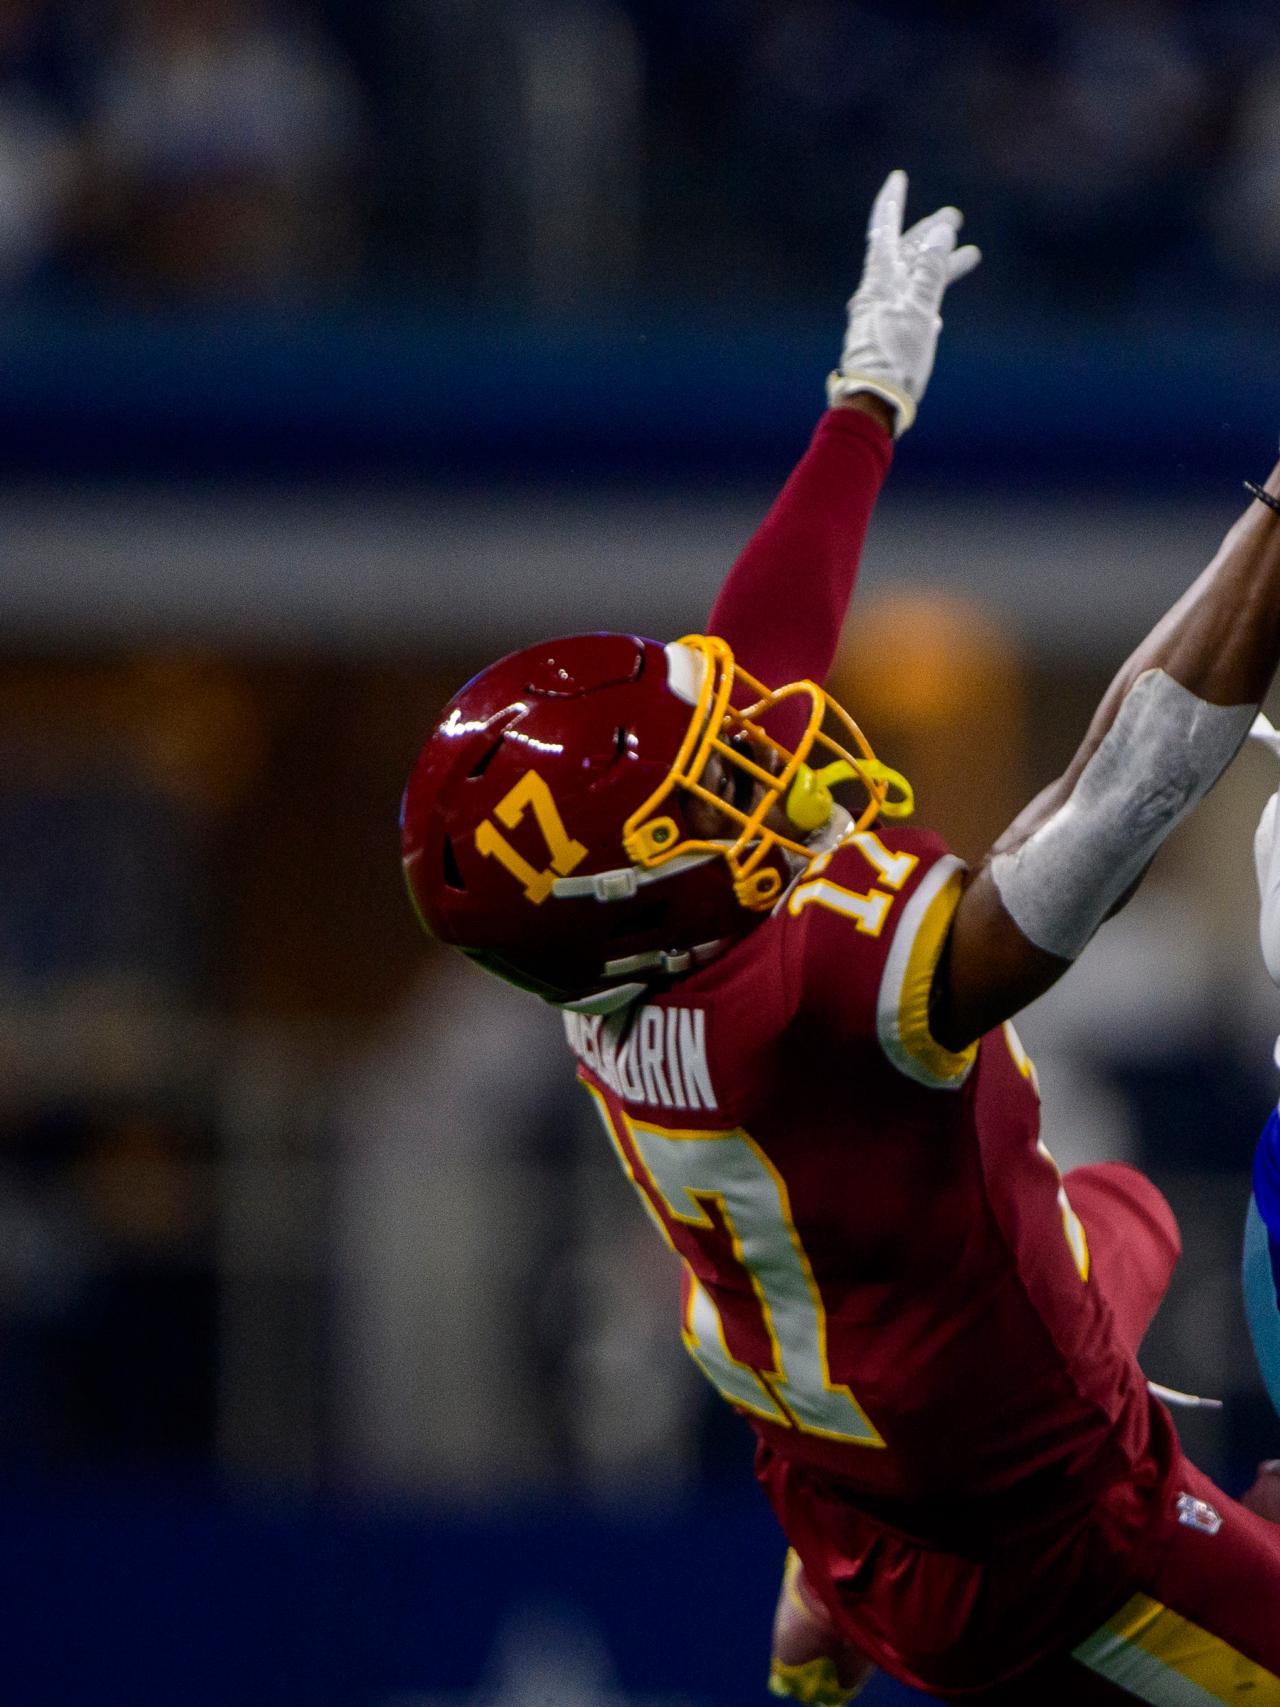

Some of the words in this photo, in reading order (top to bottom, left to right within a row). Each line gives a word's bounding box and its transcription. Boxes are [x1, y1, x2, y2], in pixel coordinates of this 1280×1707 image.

[474, 768, 590, 905] 17
[787, 830, 921, 938] 17
[561, 1004, 718, 1110] LURIN
